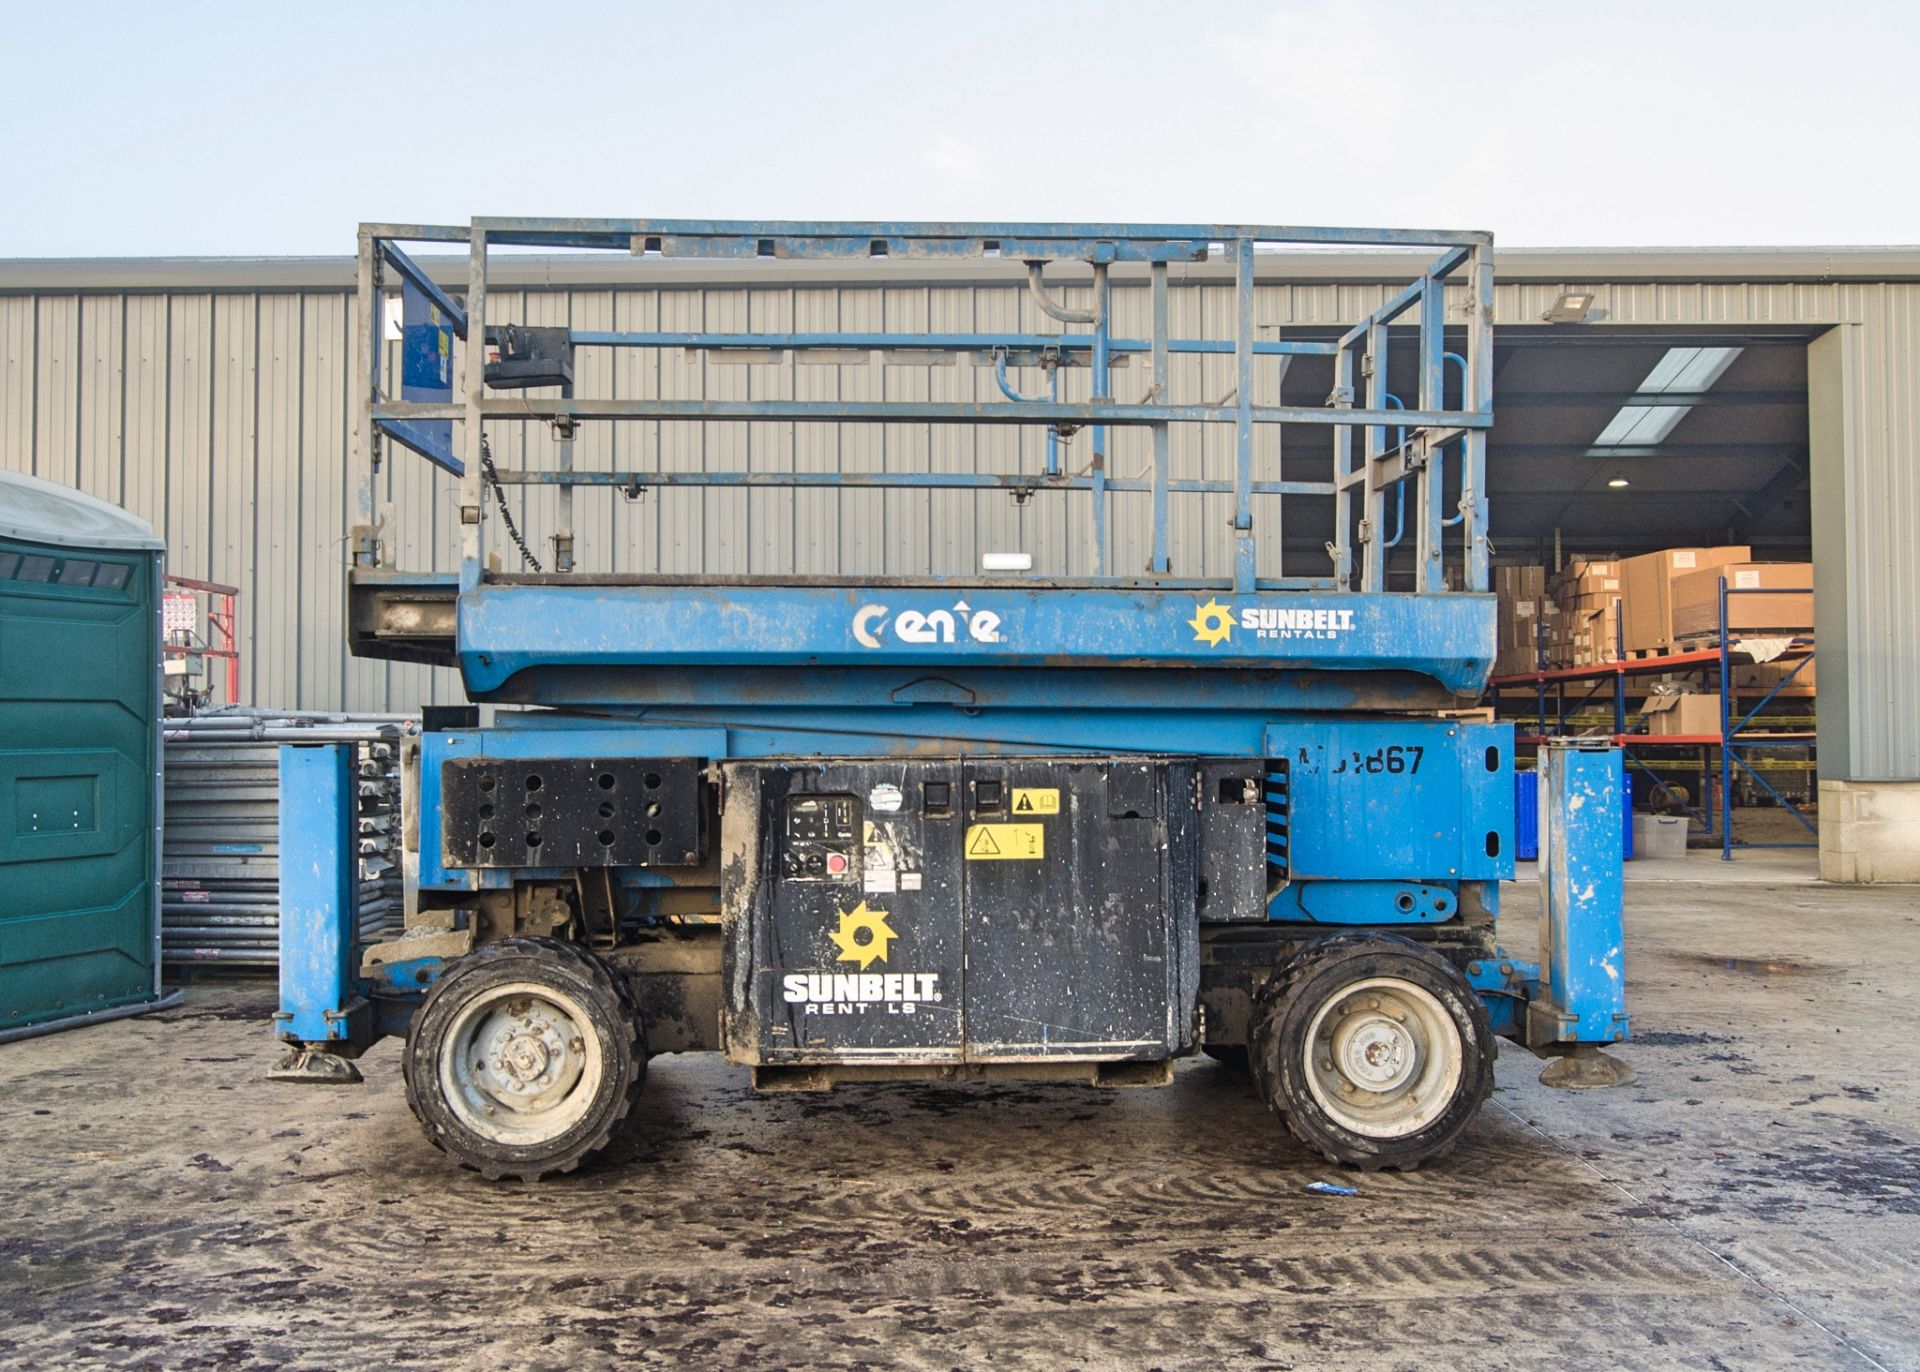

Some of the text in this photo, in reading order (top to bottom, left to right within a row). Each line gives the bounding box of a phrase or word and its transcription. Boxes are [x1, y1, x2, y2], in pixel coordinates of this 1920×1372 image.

[1241, 608, 1354, 631] SUNBELT
[1256, 630, 1337, 640] RENTALS
[783, 973, 939, 1003] SUNBELT
[805, 1002, 916, 1015] RENTLS
